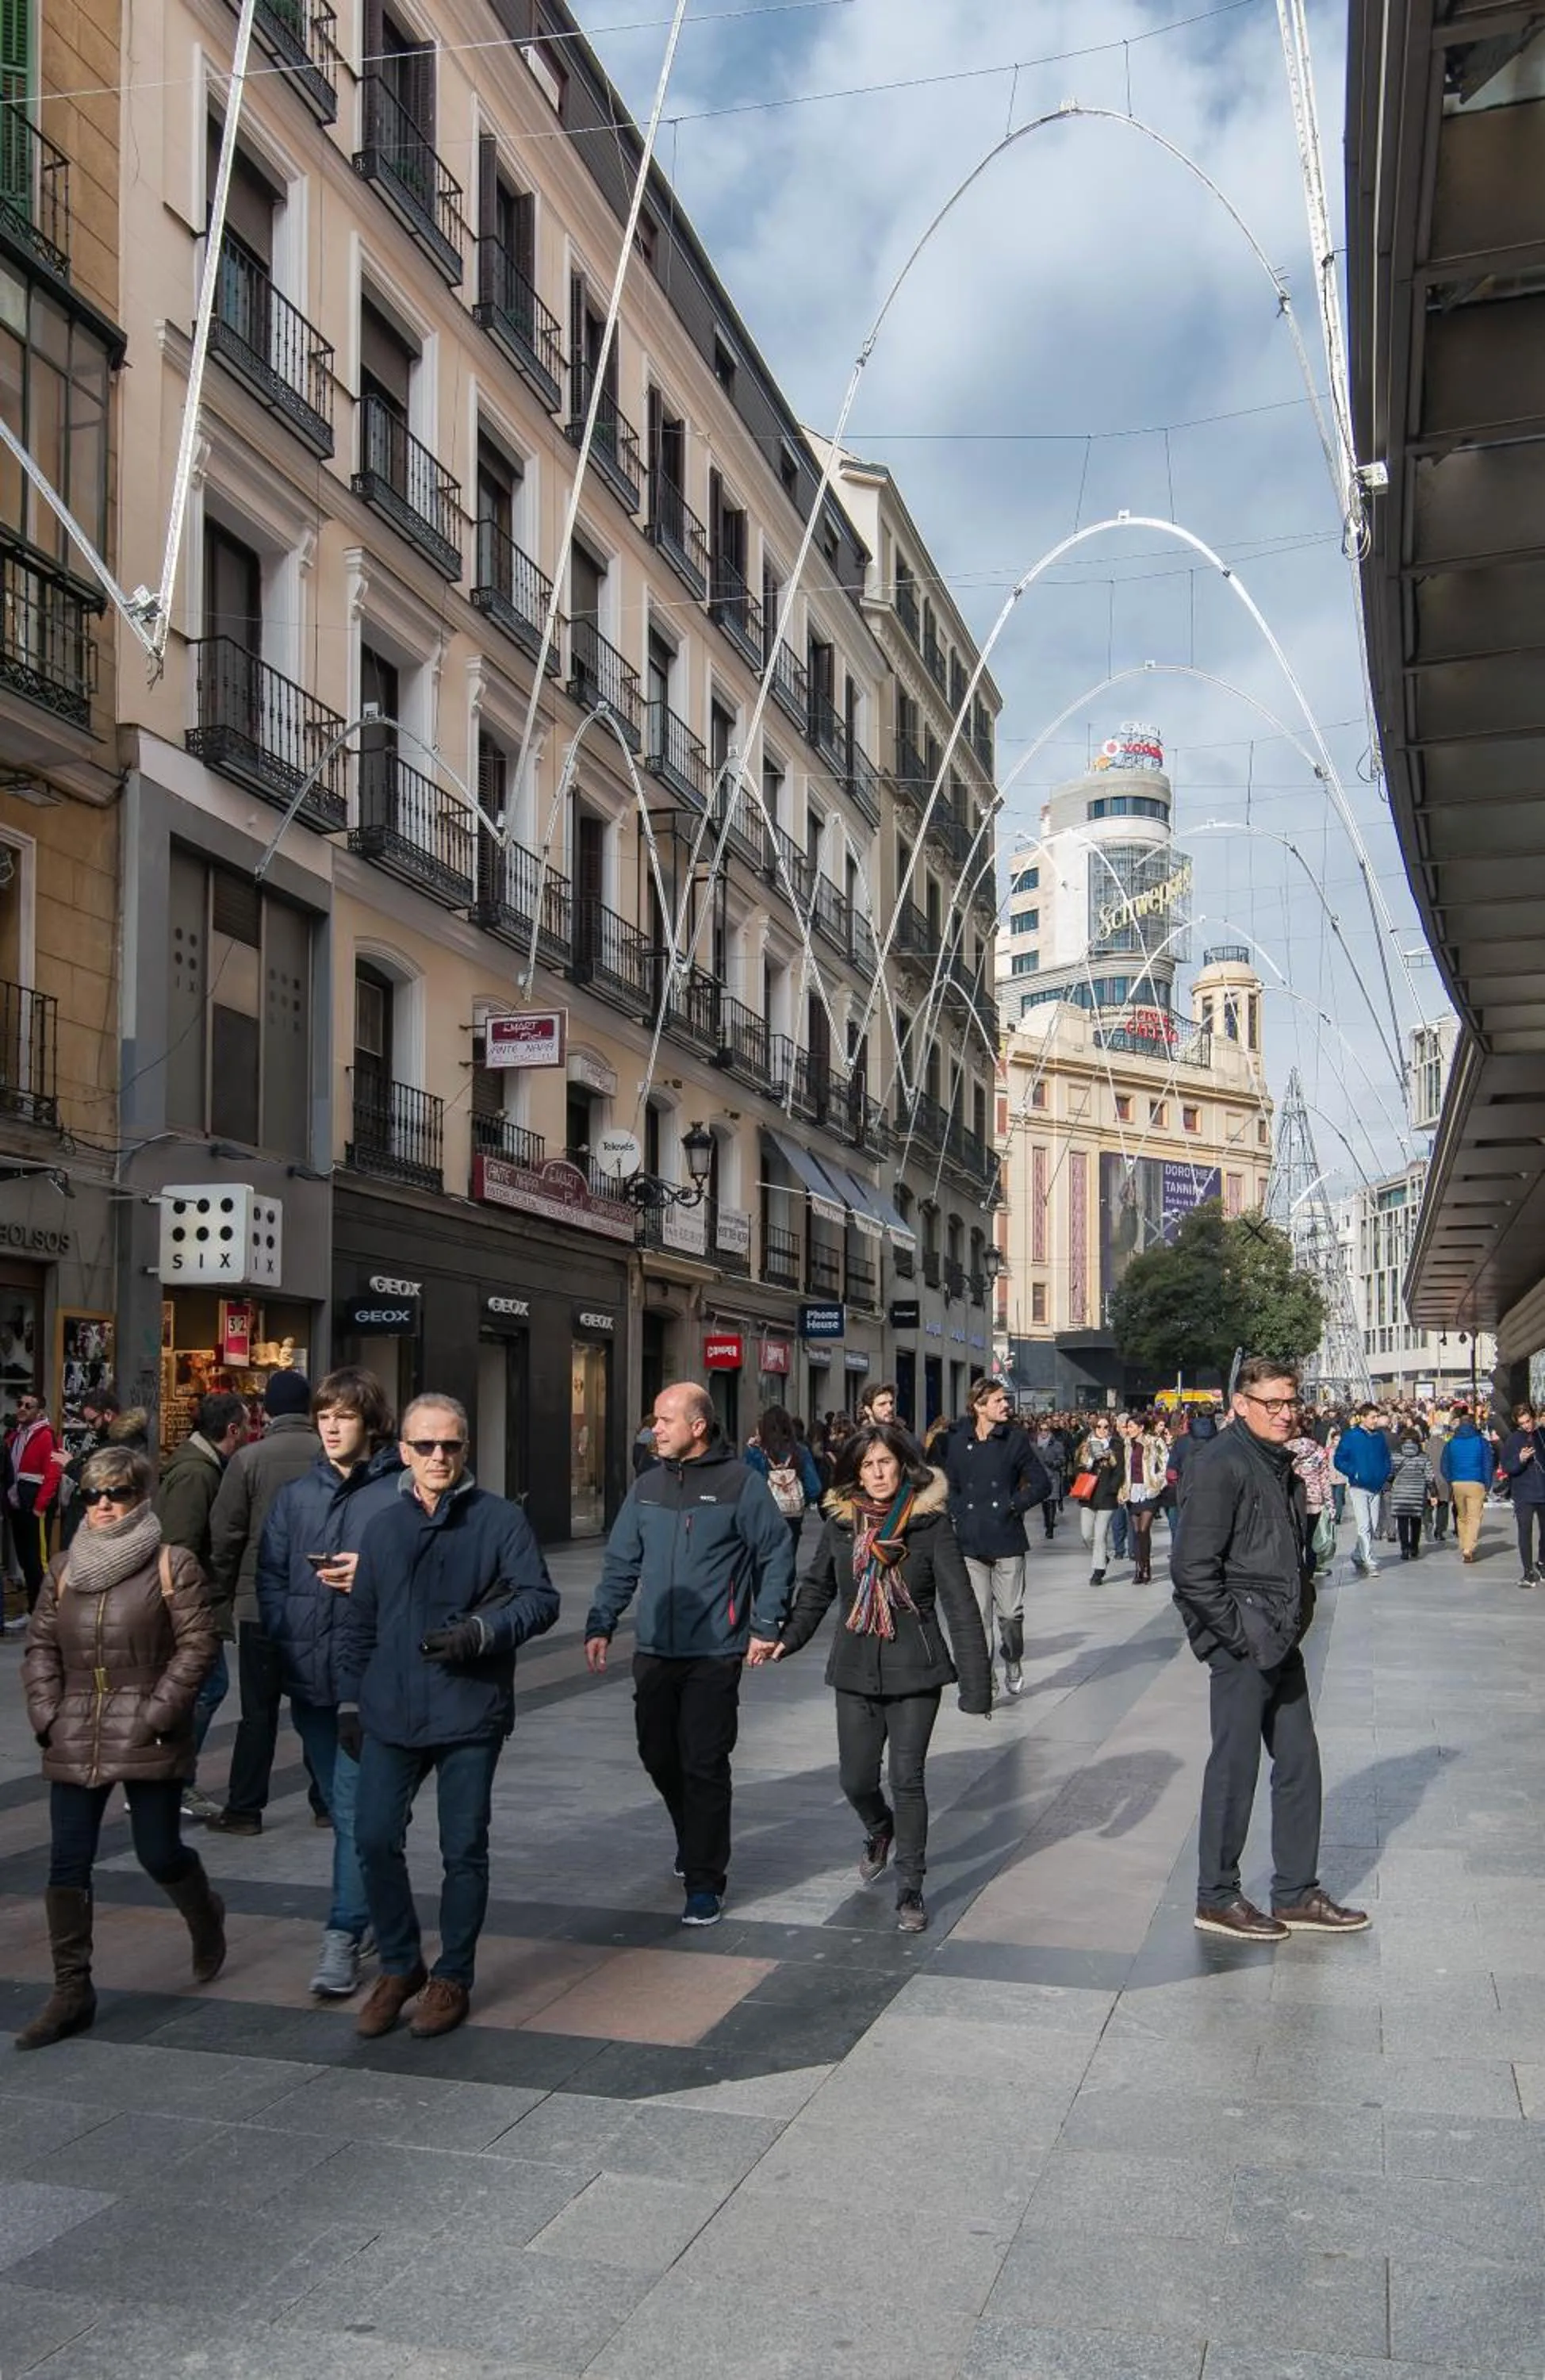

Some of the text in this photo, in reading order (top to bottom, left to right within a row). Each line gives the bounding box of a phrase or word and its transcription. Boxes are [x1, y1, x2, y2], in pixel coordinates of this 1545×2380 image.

[603, 1141, 635, 1151] Televés
[172, 1253, 231, 1269] SIX
[254, 1256, 274, 1273] IX
[369, 1275, 423, 1296] GEOX
[488, 1296, 530, 1316] GEOX
[355, 1310, 411, 1322] GEOX
[580, 1312, 615, 1330] GEOX
[806, 1310, 839, 1319] Phone
[806, 1319, 839, 1329] House
